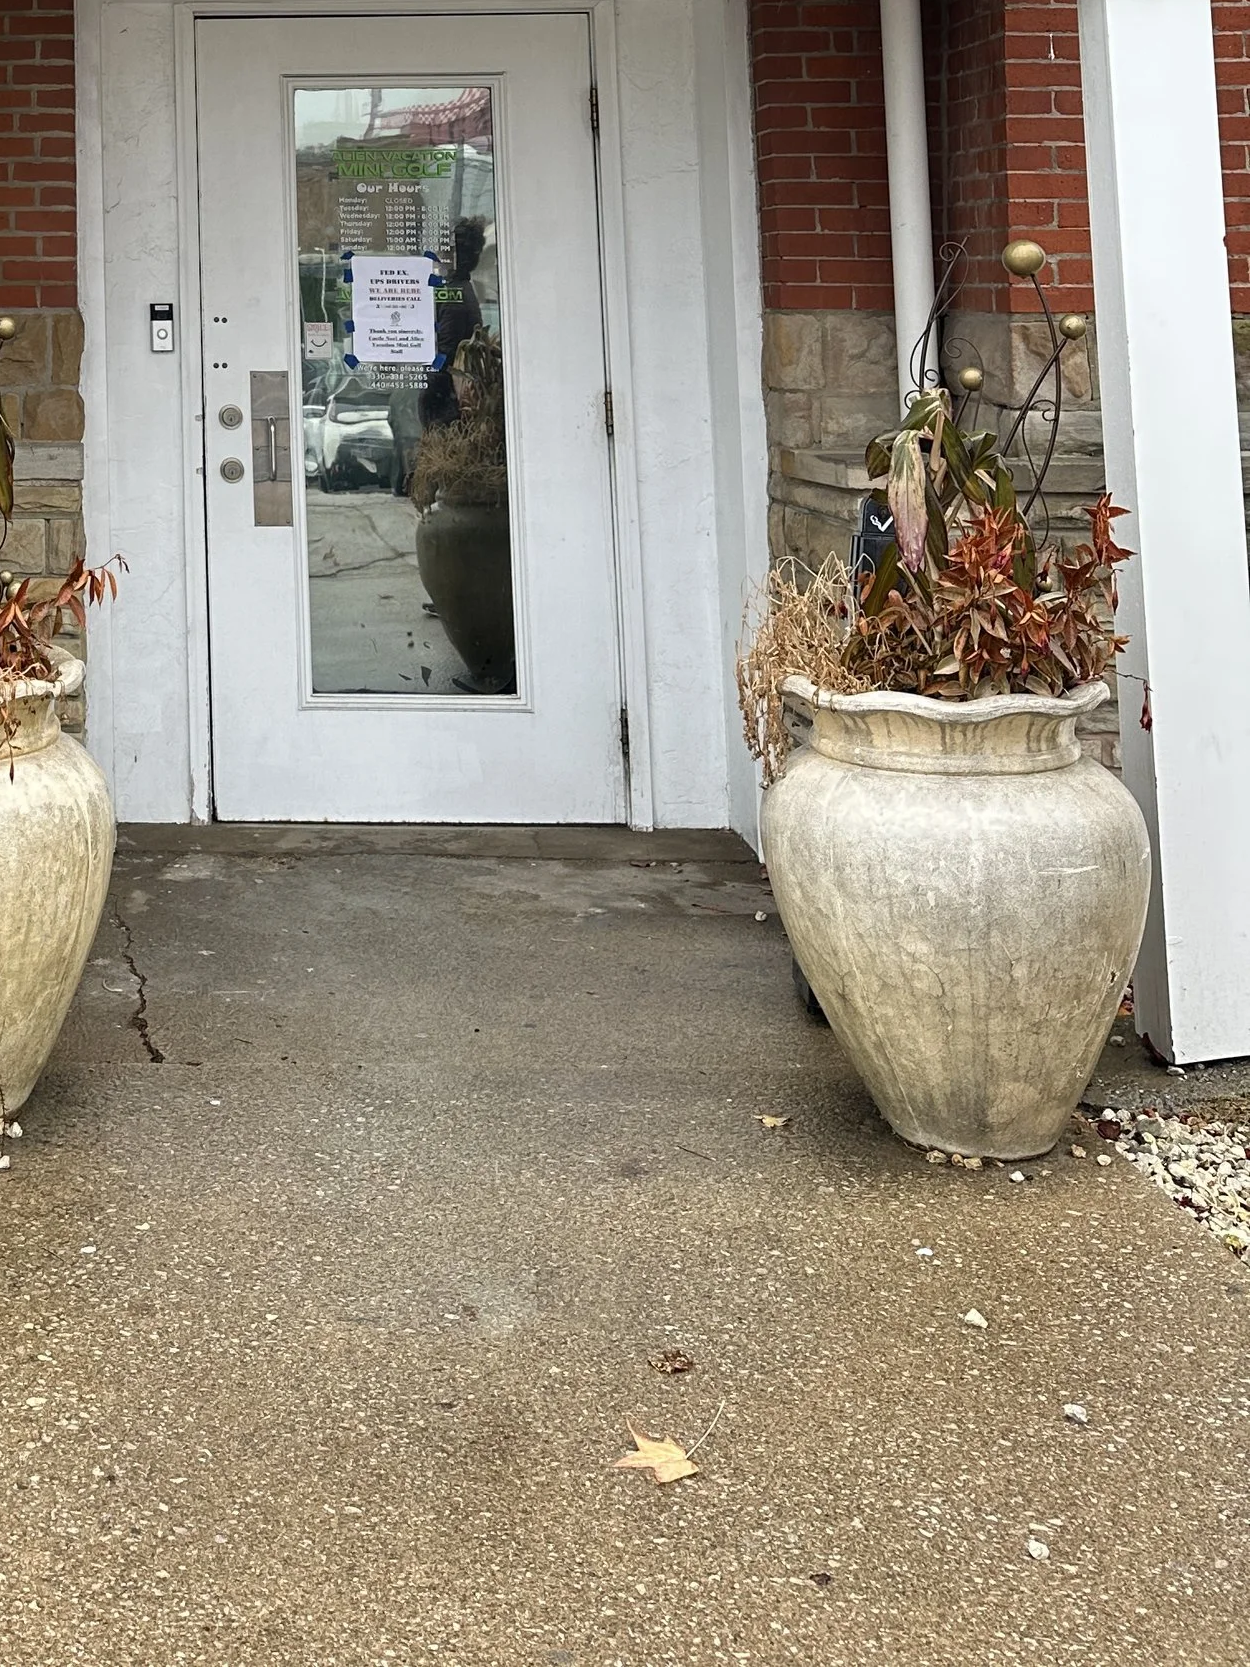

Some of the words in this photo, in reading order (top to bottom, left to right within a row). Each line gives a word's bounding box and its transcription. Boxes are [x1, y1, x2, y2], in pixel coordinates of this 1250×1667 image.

[332, 150, 377, 162] ALIEN
[381, 150, 456, 162] VACATION
[337, 162, 383, 177] MINI
[391, 162, 452, 177] GOLF
[356, 182, 383, 194] Our
[388, 182, 430, 194] Hours
[400, 364, 424, 373] please
